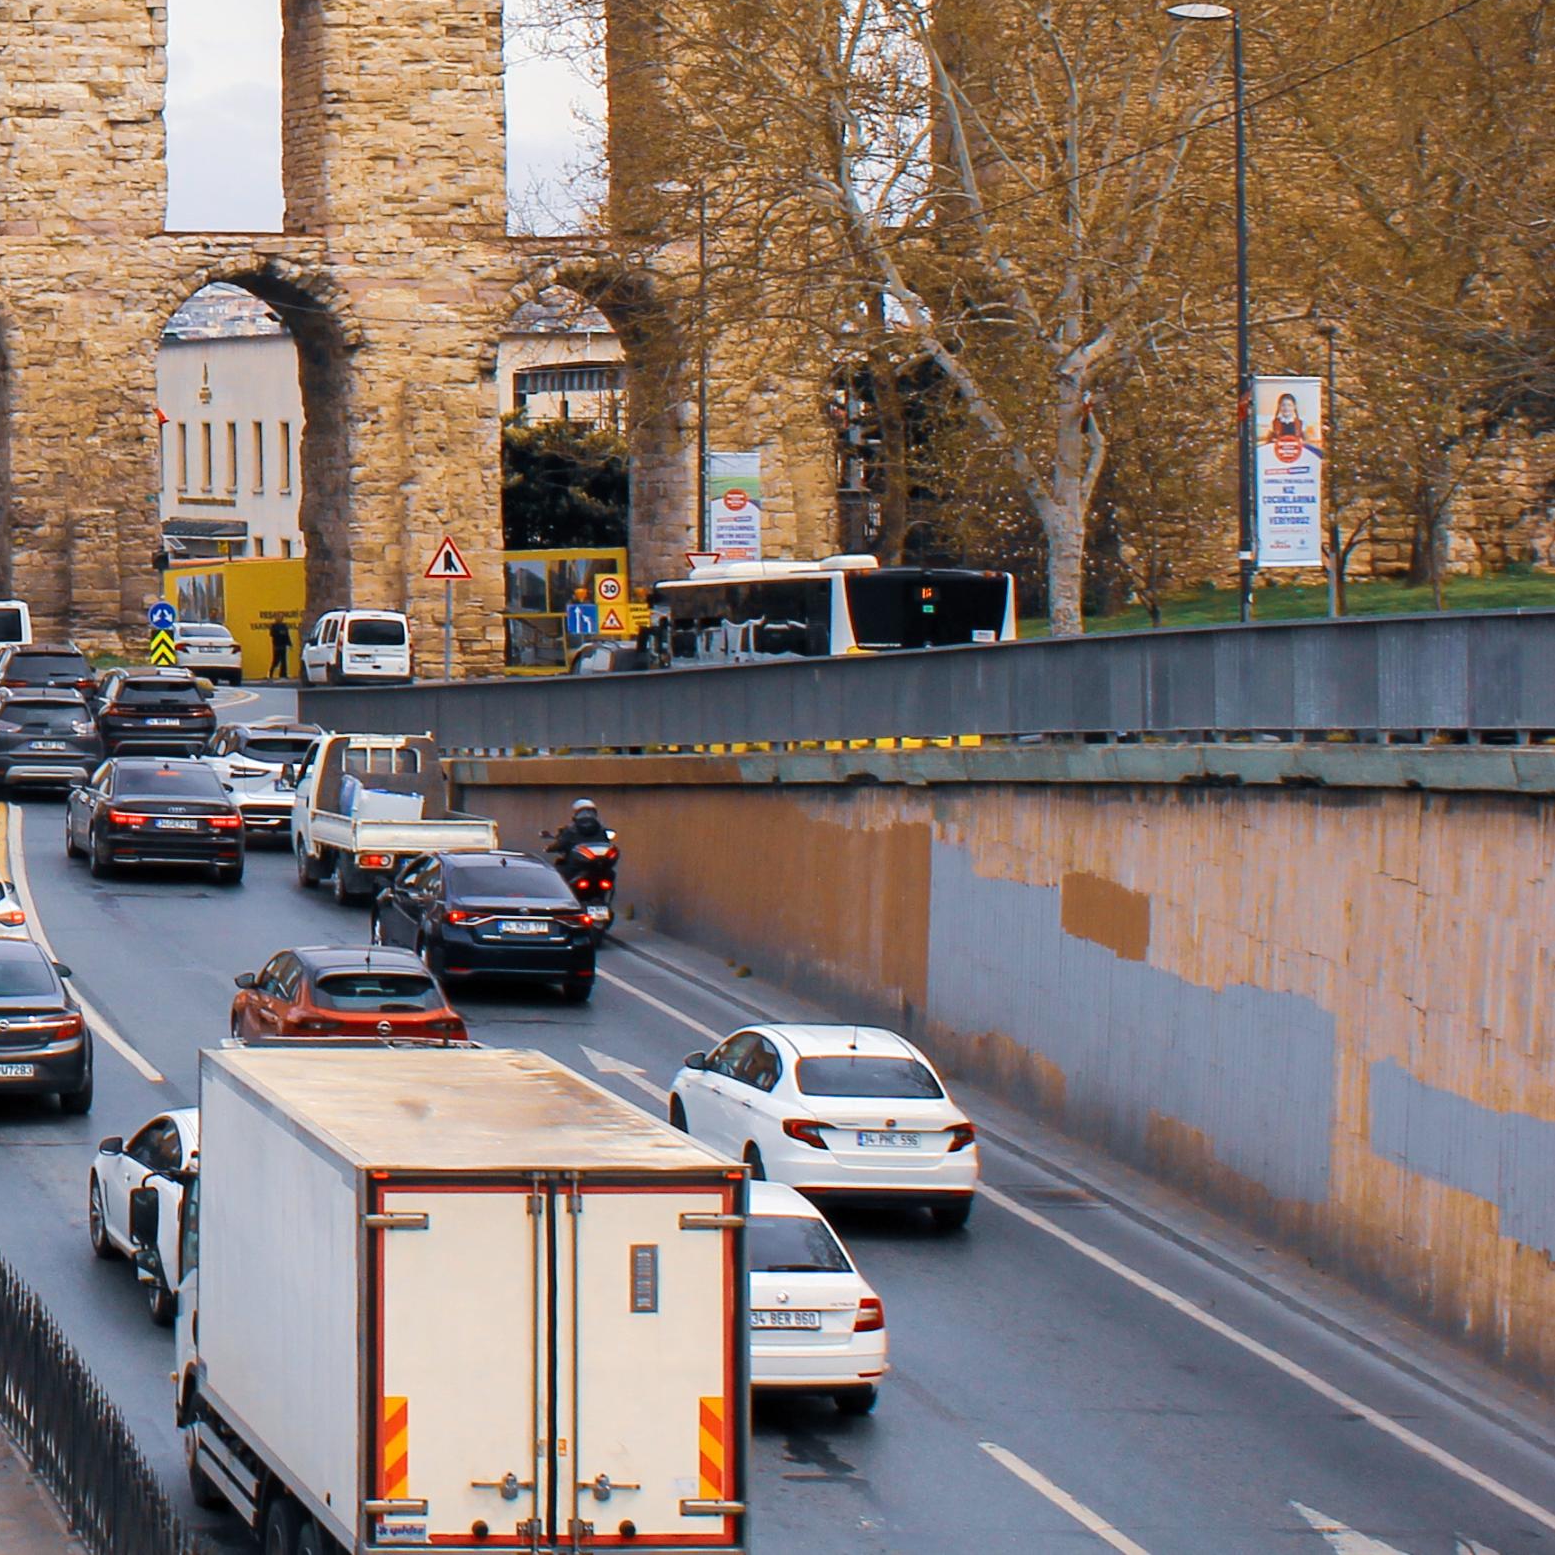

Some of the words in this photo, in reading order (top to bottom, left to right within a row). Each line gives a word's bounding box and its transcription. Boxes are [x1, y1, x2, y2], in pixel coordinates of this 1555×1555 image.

[603, 585, 617, 594] 30
[864, 1133, 875, 1144] 34
[751, 1312, 766, 1325] 34
[770, 1312, 791, 1325] BER
